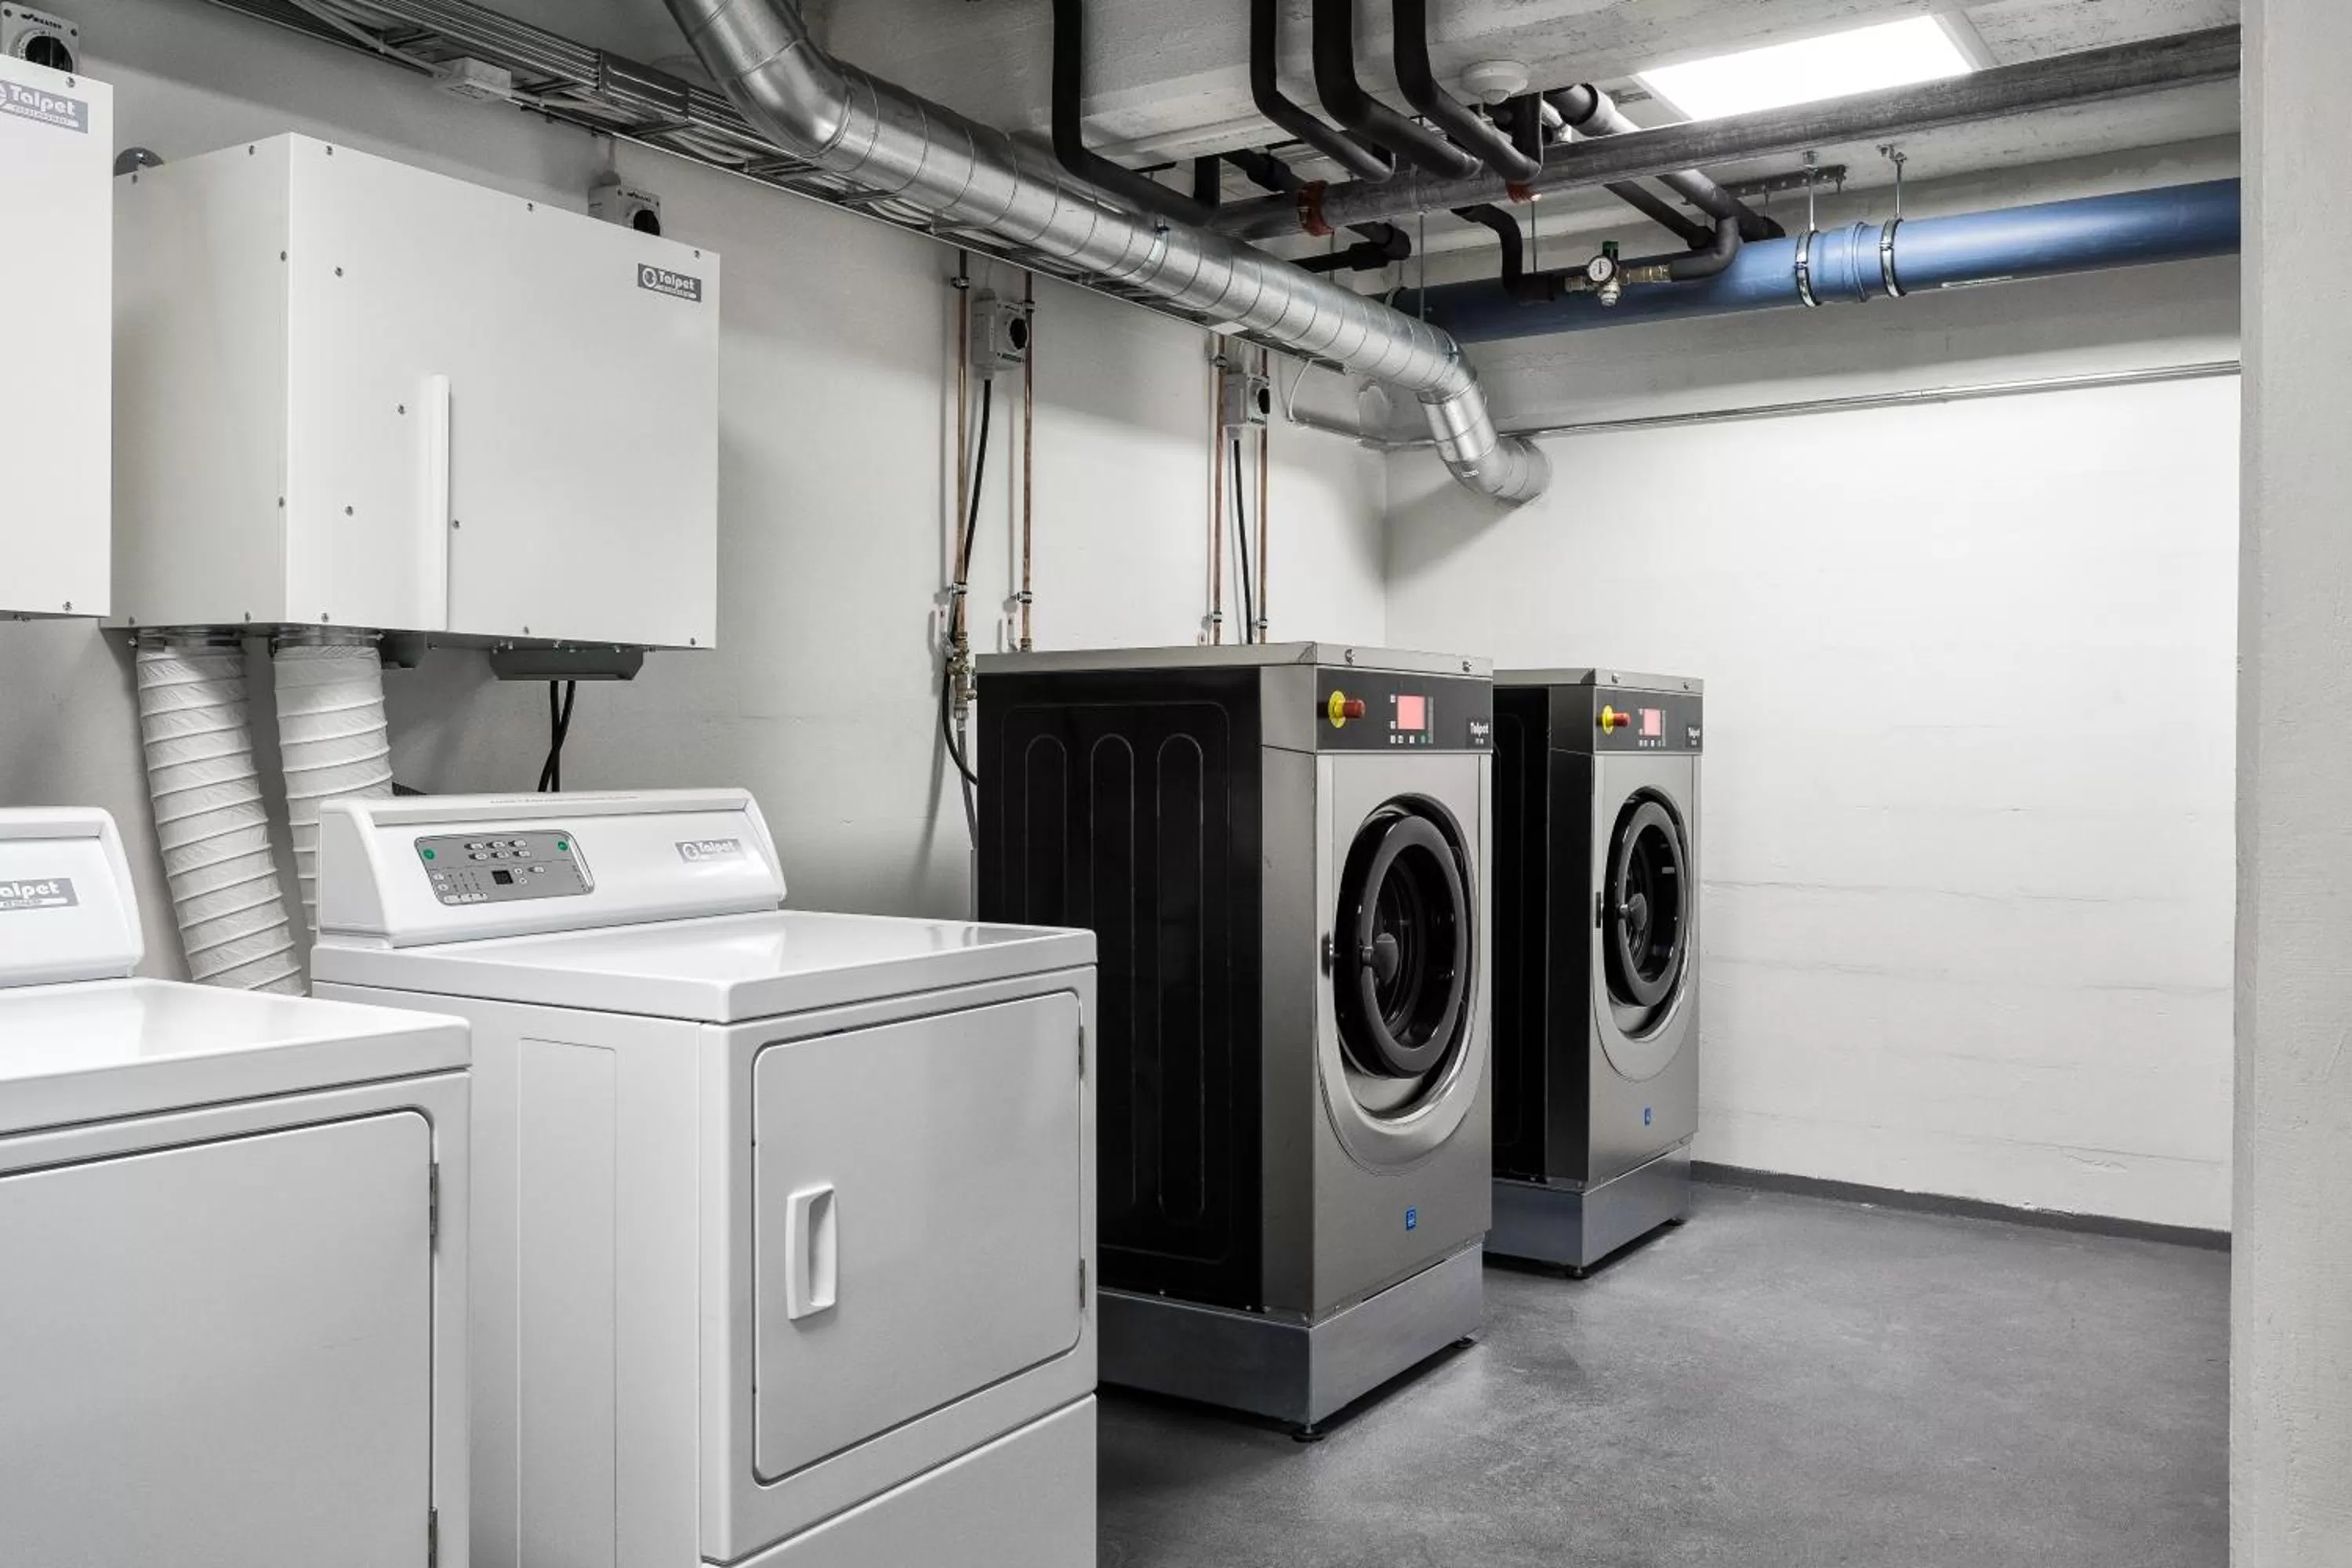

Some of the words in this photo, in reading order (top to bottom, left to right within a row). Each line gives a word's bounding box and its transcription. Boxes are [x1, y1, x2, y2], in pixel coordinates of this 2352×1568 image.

[9, 84, 76, 116] Talpet
[659, 270, 695, 290] Talpet
[0, 881, 60, 899] alpet
